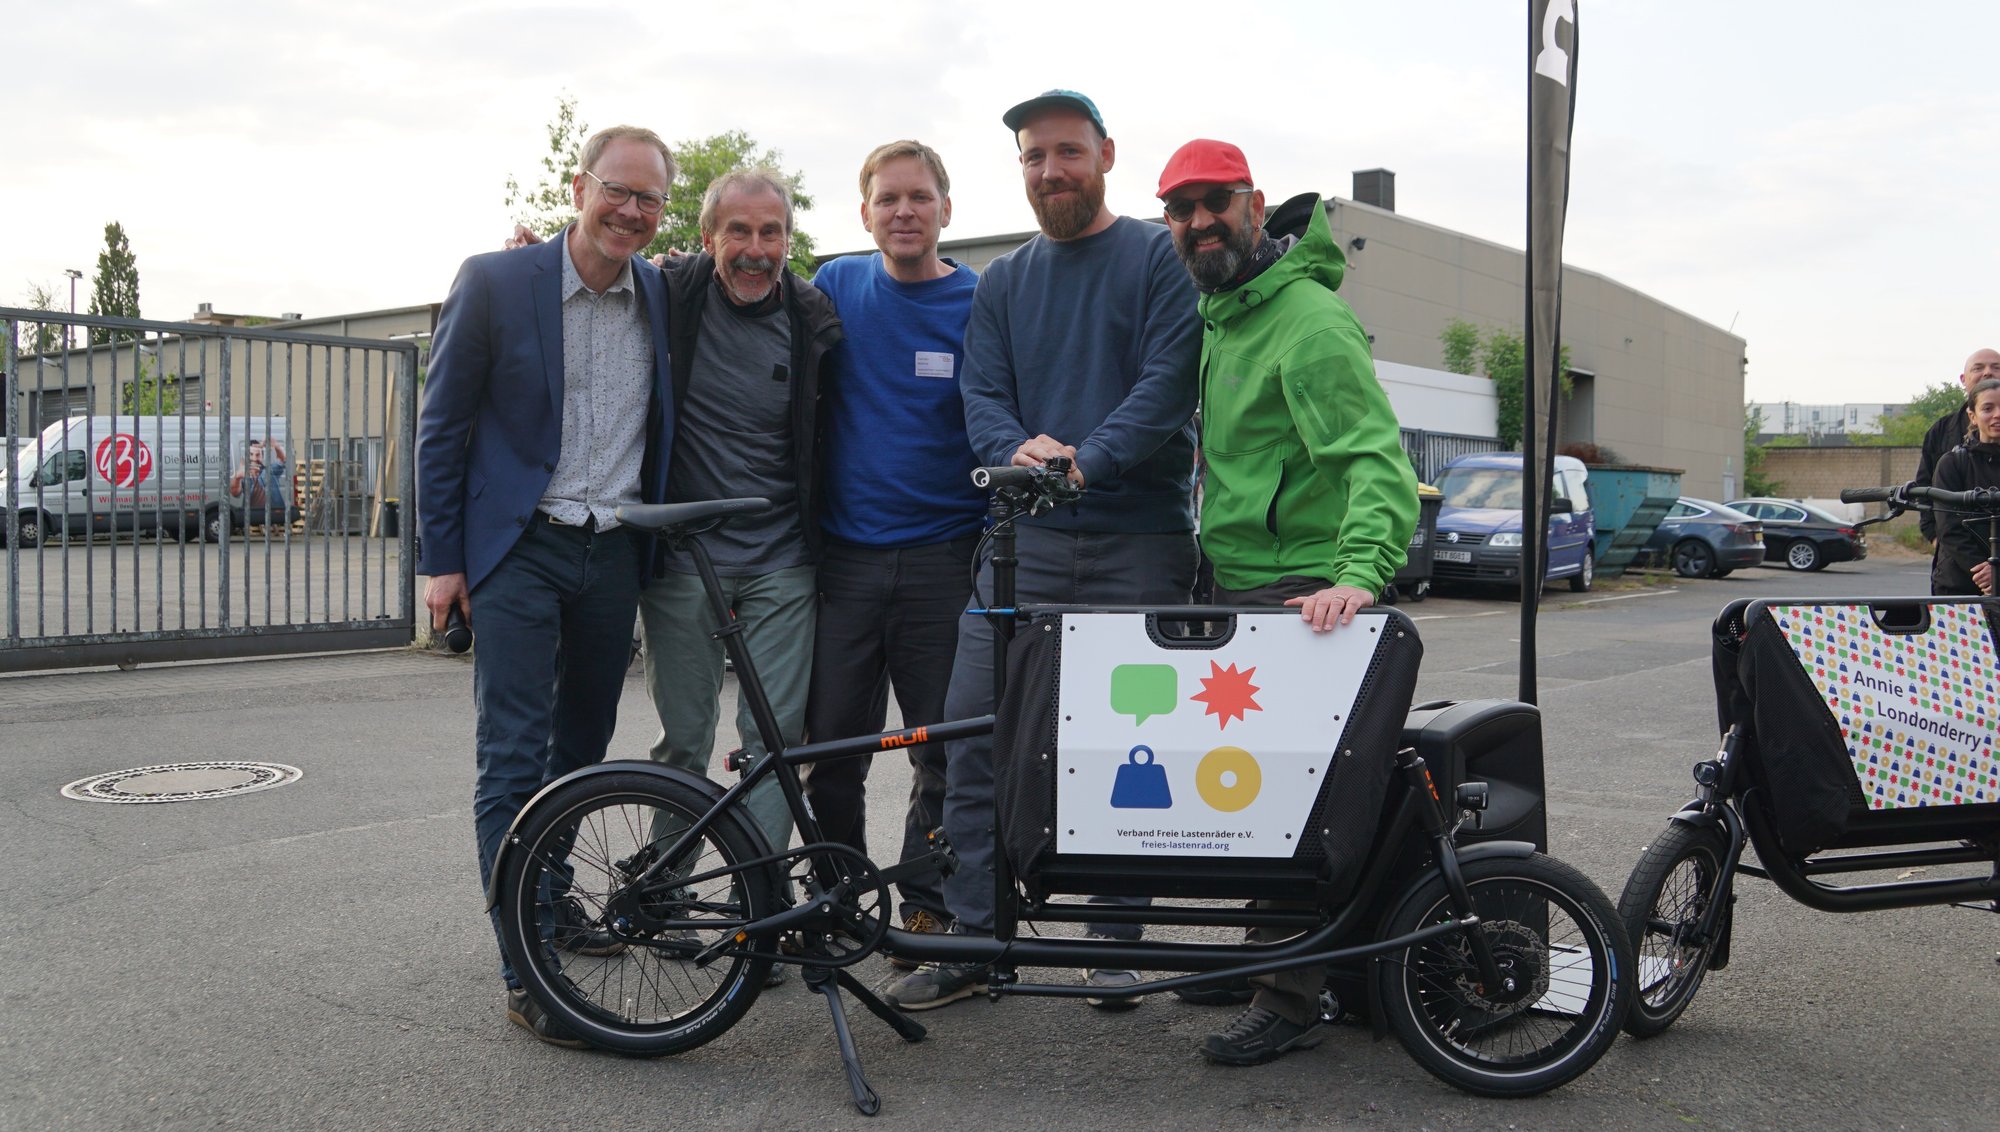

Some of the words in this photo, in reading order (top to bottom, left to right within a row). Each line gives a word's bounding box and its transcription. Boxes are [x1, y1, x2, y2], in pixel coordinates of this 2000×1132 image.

[1854, 671, 1904, 698] Annie
[881, 725, 928, 748] muli
[1877, 701, 1982, 752] Londonderry
[1116, 829, 1155, 837] Verband
[1157, 829, 1179, 838] Freie
[1181, 830, 1235, 839] Lastenräder
[1237, 831, 1254, 839] e.V.
[1141, 840, 1230, 851] freies-lastenrad.org
[1599, 1001, 1614, 1033] APPLE
